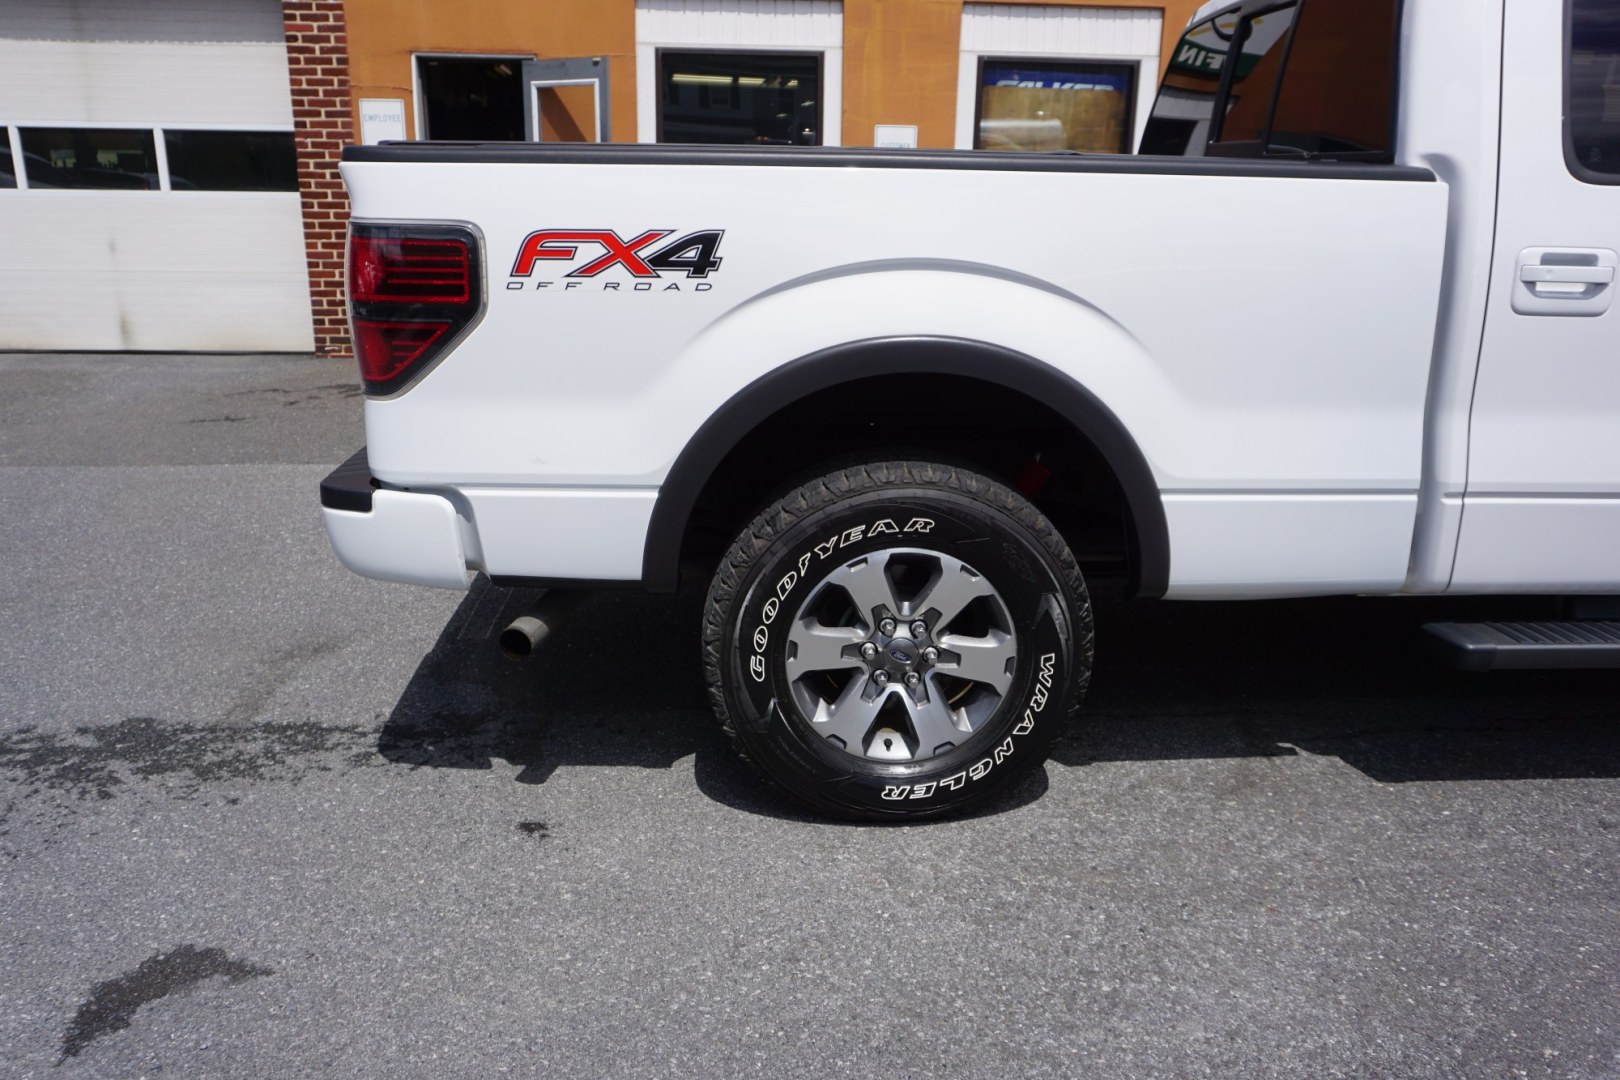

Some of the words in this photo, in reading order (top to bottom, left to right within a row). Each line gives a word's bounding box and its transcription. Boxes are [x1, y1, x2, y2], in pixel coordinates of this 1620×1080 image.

[363, 113, 401, 123] EMPLOYEE
[509, 228, 725, 278] FX4
[506, 281, 583, 291] OFF
[603, 282, 713, 292] ROAD
[750, 517, 936, 682] GOODYEAR
[881, 652, 1056, 800] WRANGLER
